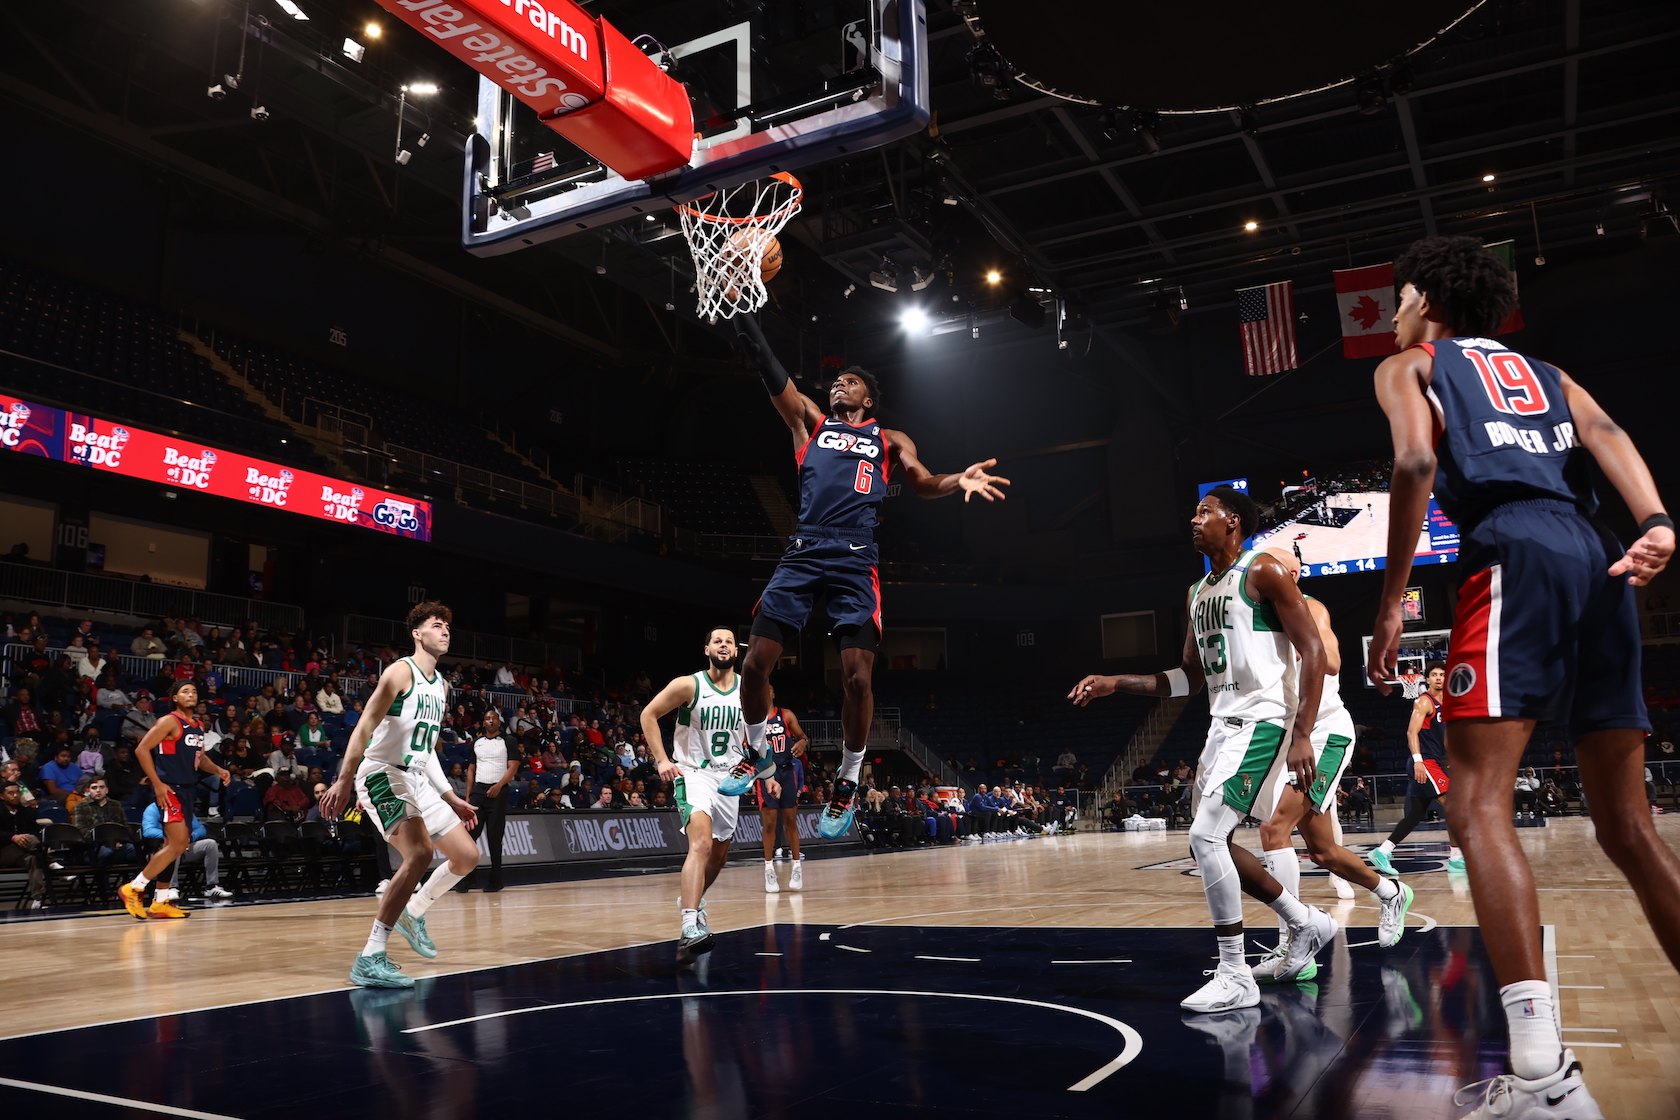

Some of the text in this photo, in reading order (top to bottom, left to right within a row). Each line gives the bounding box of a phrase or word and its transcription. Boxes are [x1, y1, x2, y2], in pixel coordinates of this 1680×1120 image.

[329, 328, 347, 347] 205
[1462, 348, 1550, 416] 19
[69, 423, 121, 450] Beat
[73, 444, 121, 468] of DC
[163, 447, 208, 472] Beat
[167, 467, 209, 488] of DC
[245, 467, 286, 491] Beat
[854, 460, 874, 494] 6
[1233, 481, 1247, 489] 19
[249, 486, 287, 506] of DC
[321, 486, 358, 507] Beat
[324, 504, 358, 522] of DC
[58, 523, 88, 549] 106
[1356, 558, 1376, 571] 14
[1439, 554, 1448, 563] 2
[1321, 564, 1348, 575] 6:28
[408, 585, 427, 603] 107
[1016, 632, 1035, 646] 109
[1199, 633, 1227, 676] 13
[410, 721, 439, 754] 00
[711, 731, 730, 757] 8
[772, 734, 786, 753] 17
[574, 819, 604, 852] NBA
[620, 817, 668, 850] LEAGUE
